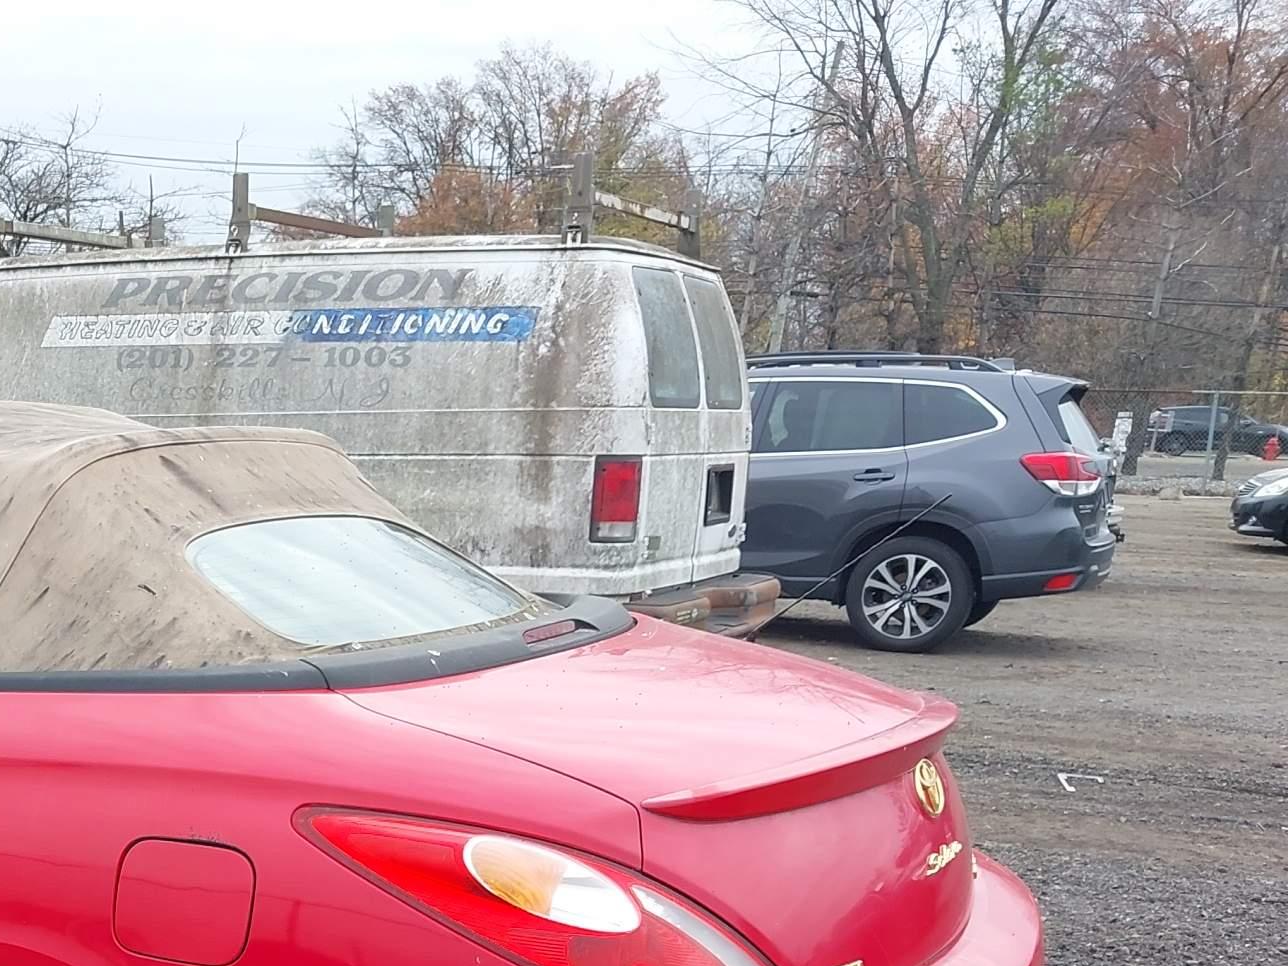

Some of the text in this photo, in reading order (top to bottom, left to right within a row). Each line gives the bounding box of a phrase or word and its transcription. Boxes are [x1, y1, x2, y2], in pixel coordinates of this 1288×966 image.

[100, 268, 475, 307] PRECISION
[58, 308, 510, 341] HEATING & AIR CONDITIONING
[115, 346, 194, 371] (201)
